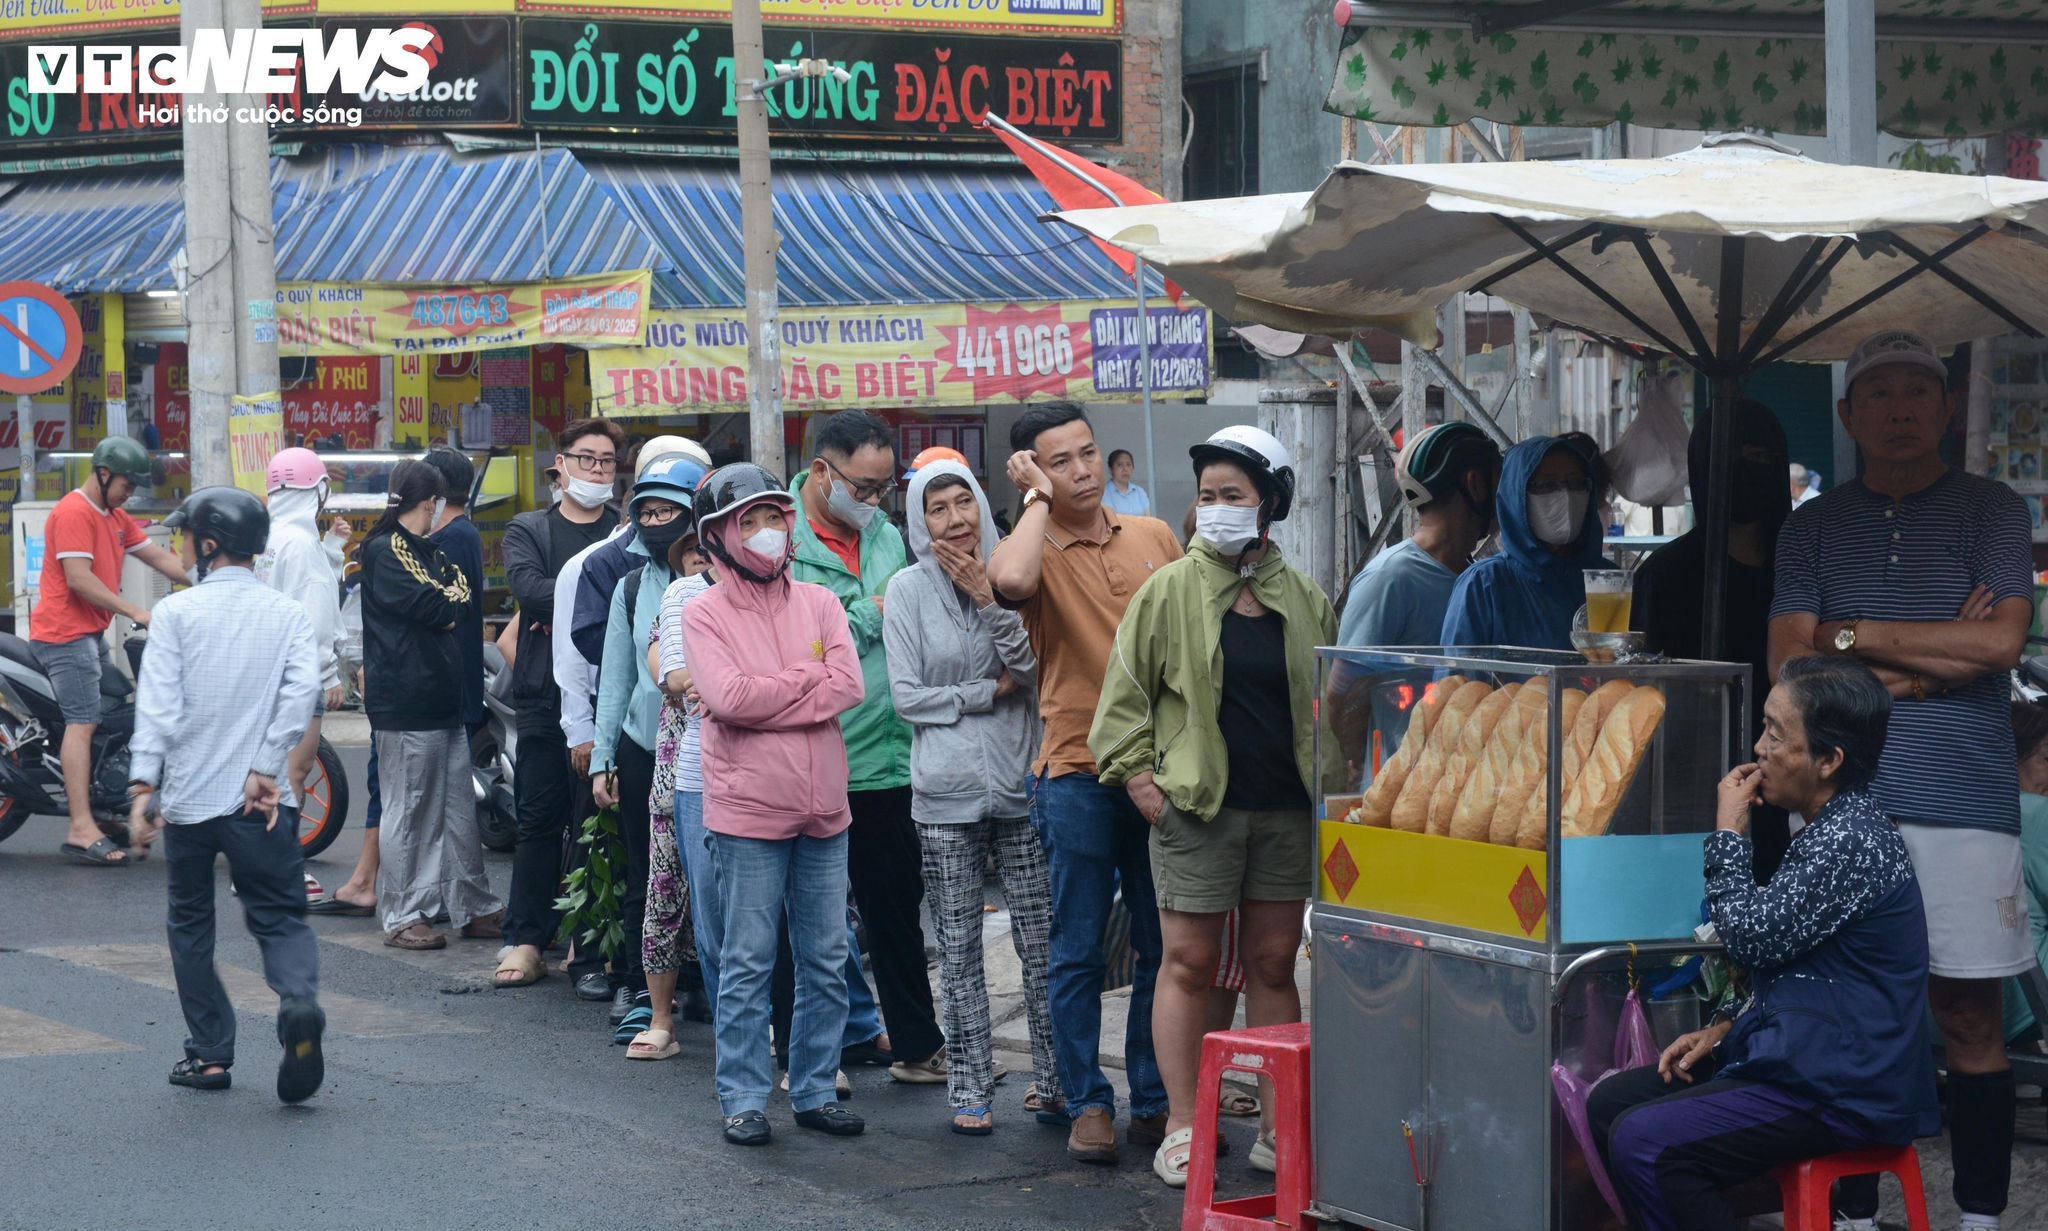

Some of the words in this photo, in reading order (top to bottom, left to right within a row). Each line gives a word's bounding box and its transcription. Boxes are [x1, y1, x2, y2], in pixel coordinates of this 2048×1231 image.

[530, 23, 619, 113] ĐỔI
[636, 28, 699, 116] SỐ
[894, 47, 990, 133] ĐẶC
[1005, 51, 1112, 137] BIỆT
[288, 286, 312, 304] QUÝ
[319, 287, 363, 302] KHÁCH
[411, 294, 509, 326] 487643
[605, 287, 638, 310] THÁP
[278, 312, 323, 353] ĐẶC
[328, 308, 377, 350] BIỆT
[391, 337, 425, 352] TẠI
[432, 336, 467, 350] ĐẠI
[645, 318, 687, 348] ÚC
[695, 317, 749, 347] MỪN
[782, 315, 830, 347] QUÝ
[839, 314, 924, 343] KHÁCH
[1095, 310, 1120, 346] ĐÀI
[1123, 316, 1157, 345] KIN
[1160, 314, 1202, 345] GIANG
[956, 324, 1073, 377] 441966
[332, 361, 368, 390] PHÚ
[607, 360, 747, 406] TRÚNG
[780, 356, 841, 408] ẶC
[855, 353, 938, 405] BIỆT
[1097, 353, 1131, 389] NGÀY
[1135, 357, 1205, 388] 2/12/2024
[399, 396, 423, 424] SAU
